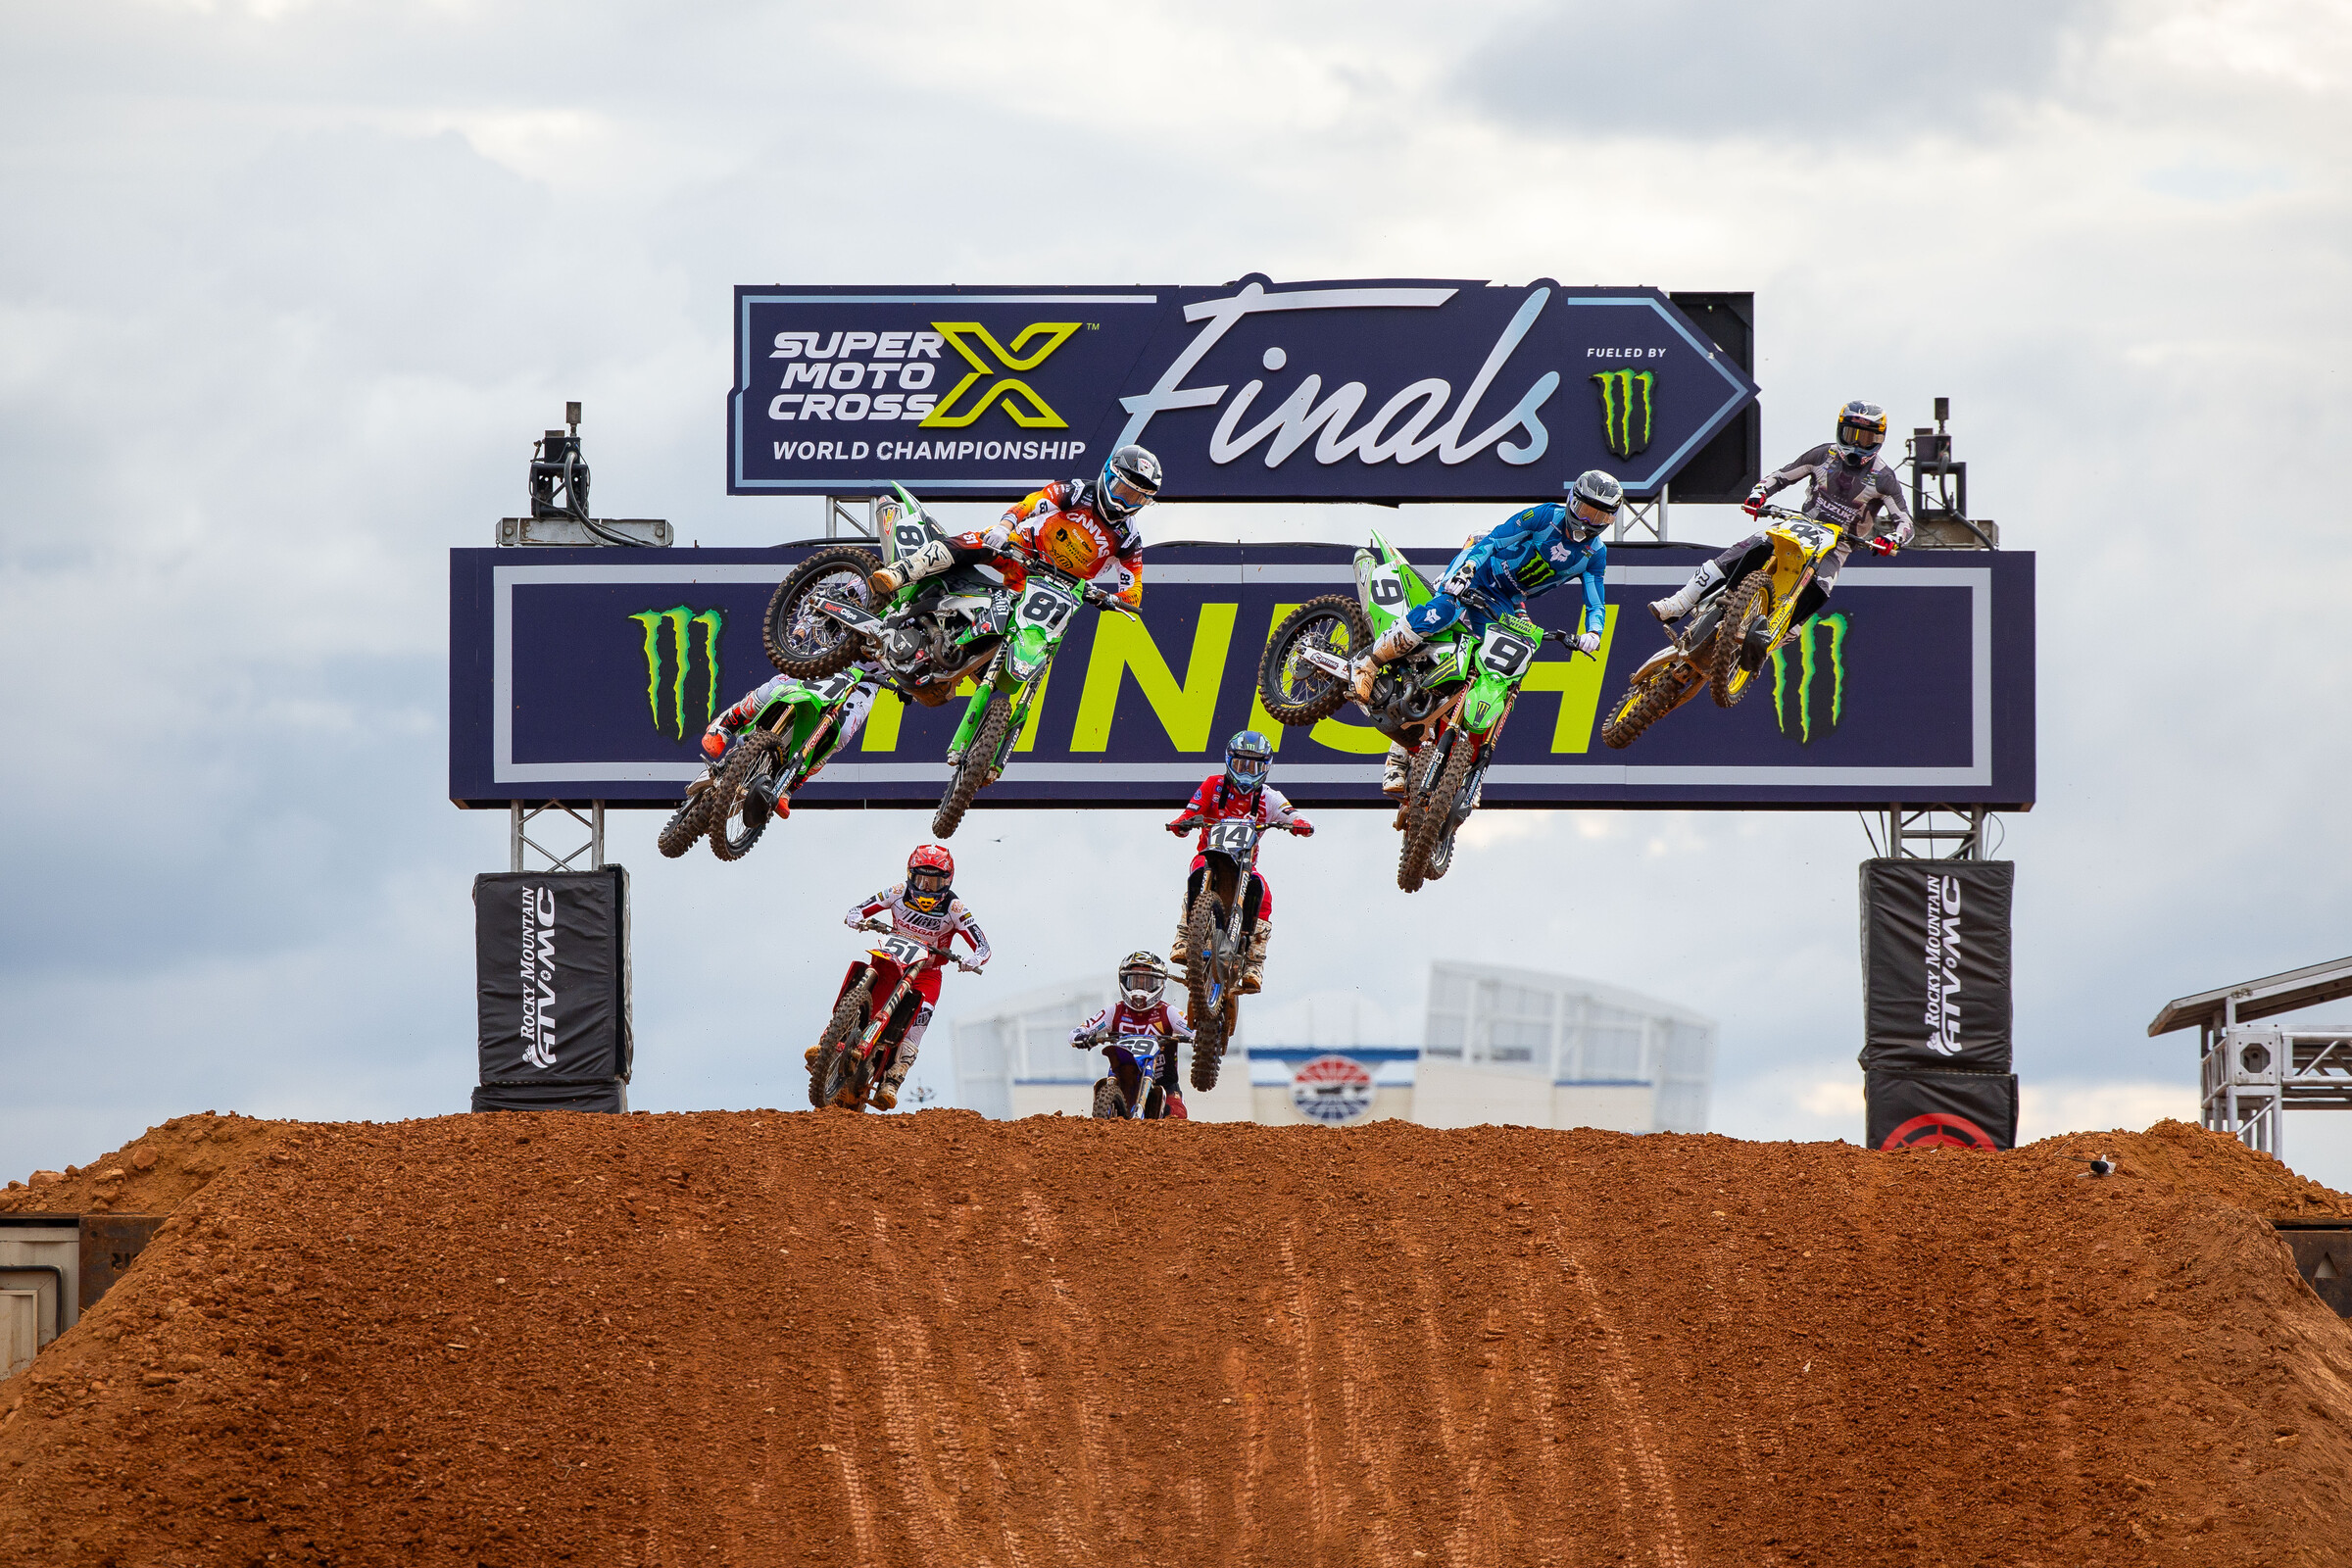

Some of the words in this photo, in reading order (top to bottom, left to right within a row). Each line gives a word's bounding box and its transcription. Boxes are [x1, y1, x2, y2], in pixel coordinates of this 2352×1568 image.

[768, 331, 945, 359] SUPER
[1587, 348, 1642, 359] FUELED
[1647, 348, 1666, 359] BY
[780, 363, 935, 390] MOTO
[1107, 282, 1560, 468] Finals
[768, 393, 936, 420] CROSS
[773, 441, 869, 460] WORLD
[876, 441, 1086, 461] CHAMPIONSHIP
[1039, 500, 1049, 514] 81
[1816, 496, 1855, 522] SUZUKI
[962, 533, 979, 545] 81
[1066, 512, 1110, 559] CANVAS
[1120, 572, 1131, 587] 81
[1371, 578, 1405, 606] 9
[1500, 561, 1528, 596] Kawa
[824, 602, 858, 621] SportClips
[1022, 591, 1072, 631] 81
[1503, 613, 1534, 629] ENTHAL
[1768, 608, 1787, 634] DUNLOP
[1459, 635, 1470, 658] KX
[1484, 636, 1529, 676] 9
[1003, 728, 1020, 765] DUNLOP
[1211, 825, 1249, 849] 14
[520, 886, 535, 982] MOUNTAIN
[1229, 912, 1241, 943] DUNLOP
[1925, 874, 1940, 970] MOUNTAIN
[885, 937, 920, 965] 51
[520, 984, 535, 1040] ROCKY
[1925, 970, 1940, 1029] ROCKY
